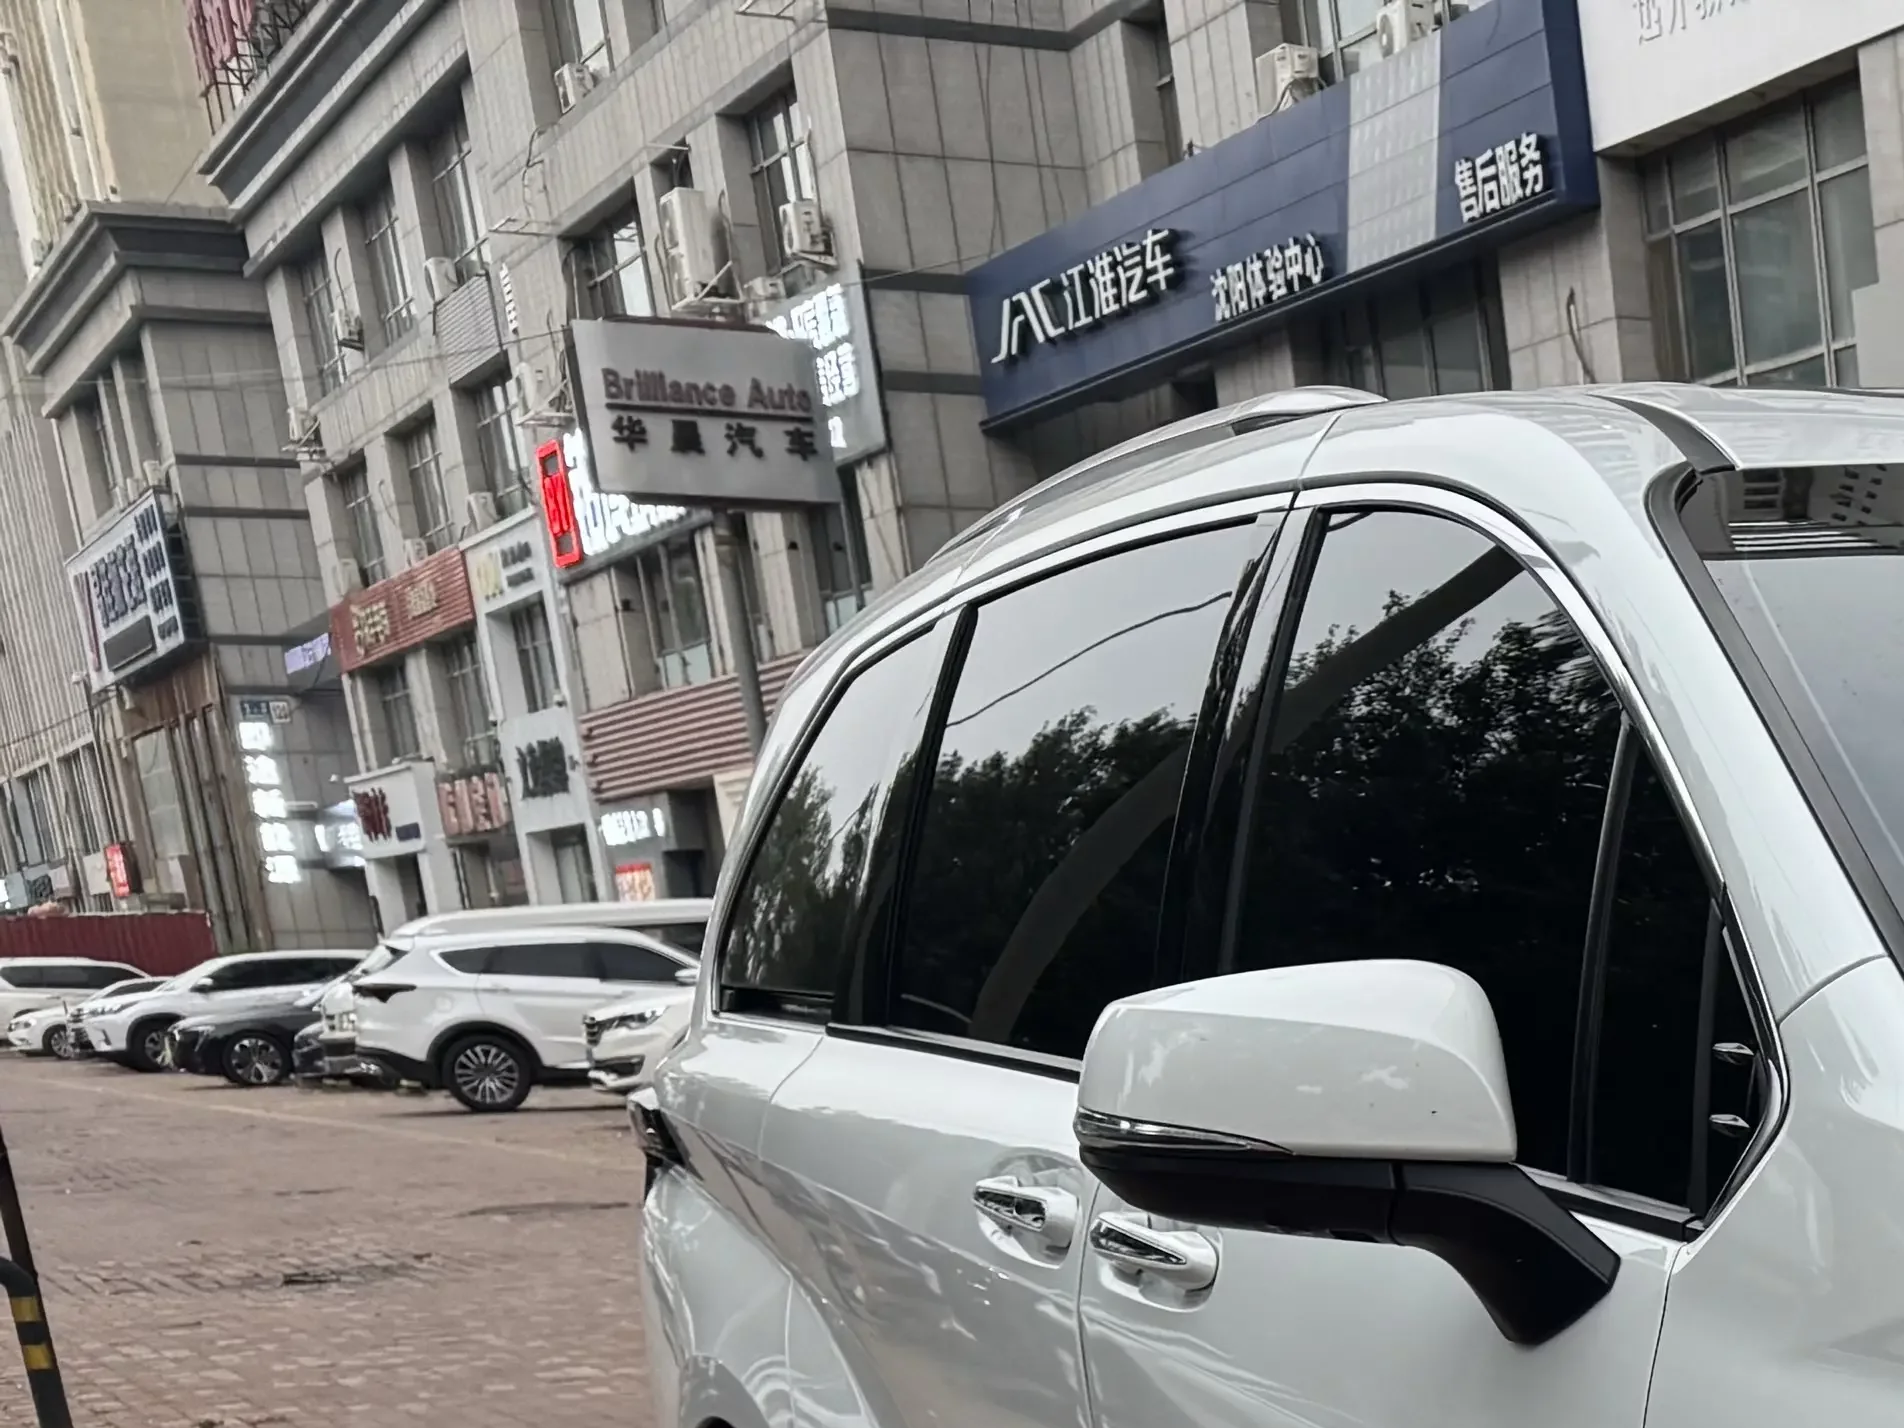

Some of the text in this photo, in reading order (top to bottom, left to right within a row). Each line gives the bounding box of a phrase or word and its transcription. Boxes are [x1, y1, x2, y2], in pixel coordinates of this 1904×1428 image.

[1454, 131, 1545, 223] 售后服务
[1060, 228, 1176, 331] 江淮汽车
[1210, 231, 1327, 323] 沈阳体验中心
[601, 367, 814, 414] Brilliance Auto
